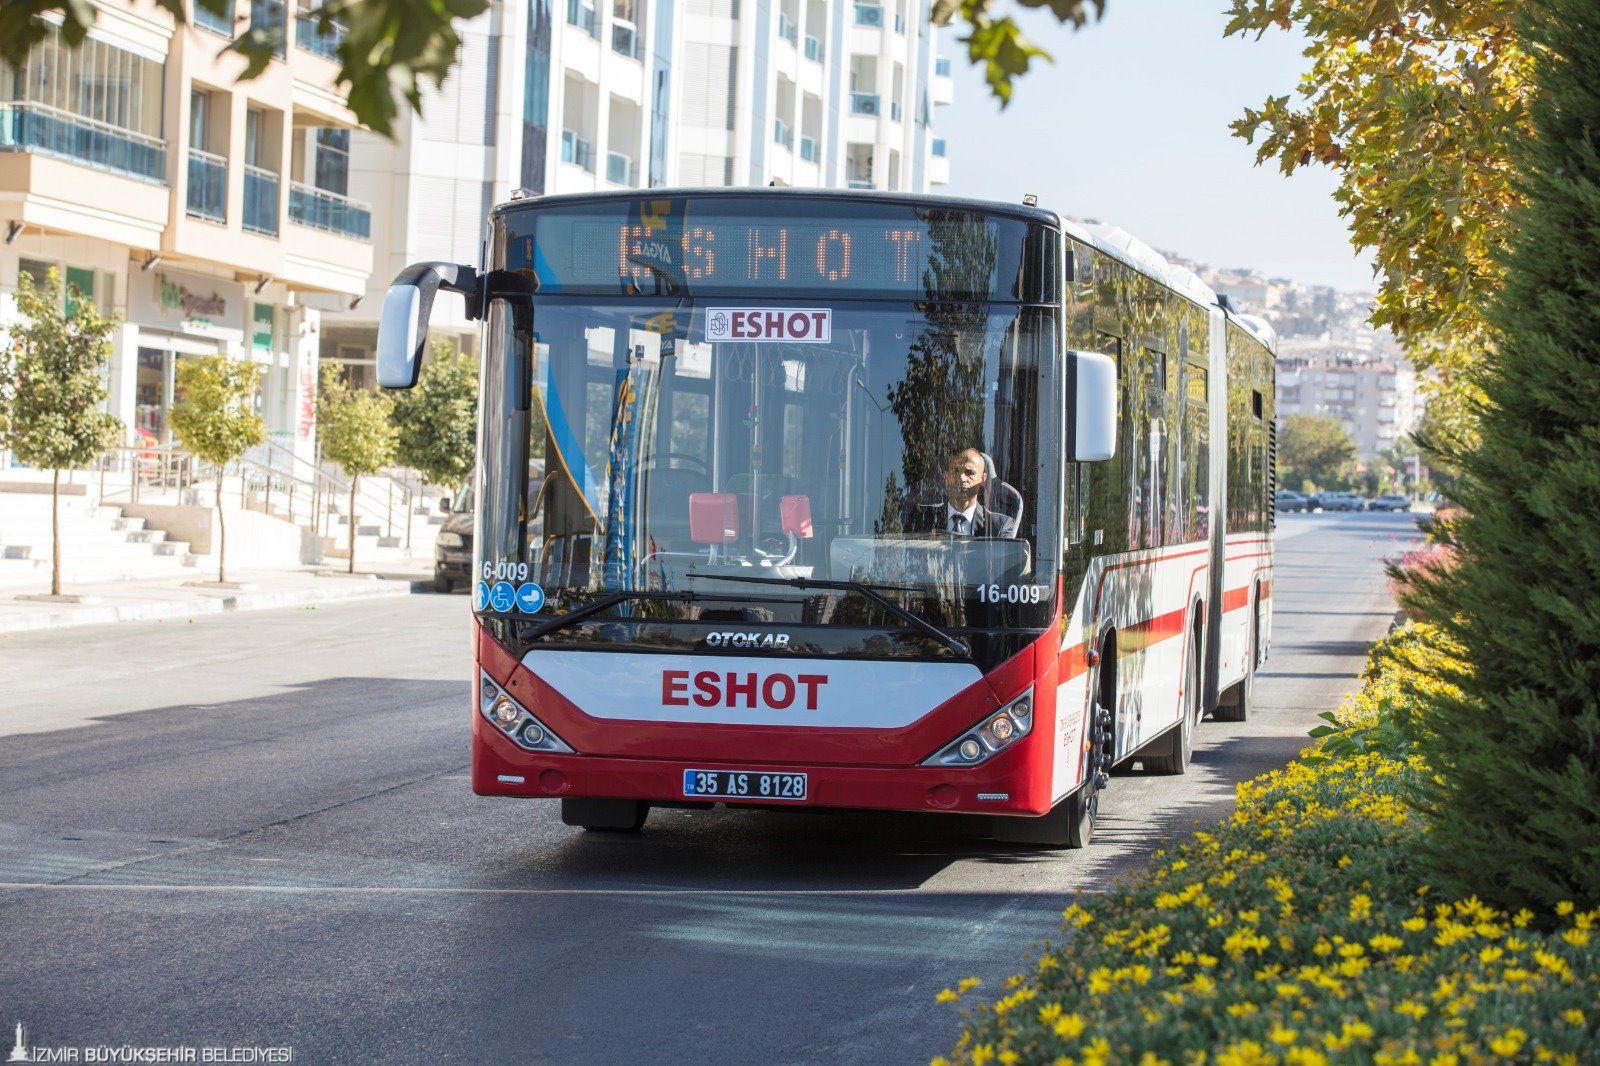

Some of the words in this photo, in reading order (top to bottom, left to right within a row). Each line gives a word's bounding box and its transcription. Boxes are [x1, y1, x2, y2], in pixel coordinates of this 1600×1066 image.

[619, 226, 920, 281] ESHOT
[731, 311, 827, 339] ESHOT
[976, 583, 1041, 605] 16-009
[706, 631, 790, 648] OTOKAR
[661, 670, 829, 710] ESHOT
[696, 772, 718, 794] 35
[726, 774, 749, 795] AS
[760, 775, 804, 797] 8128
